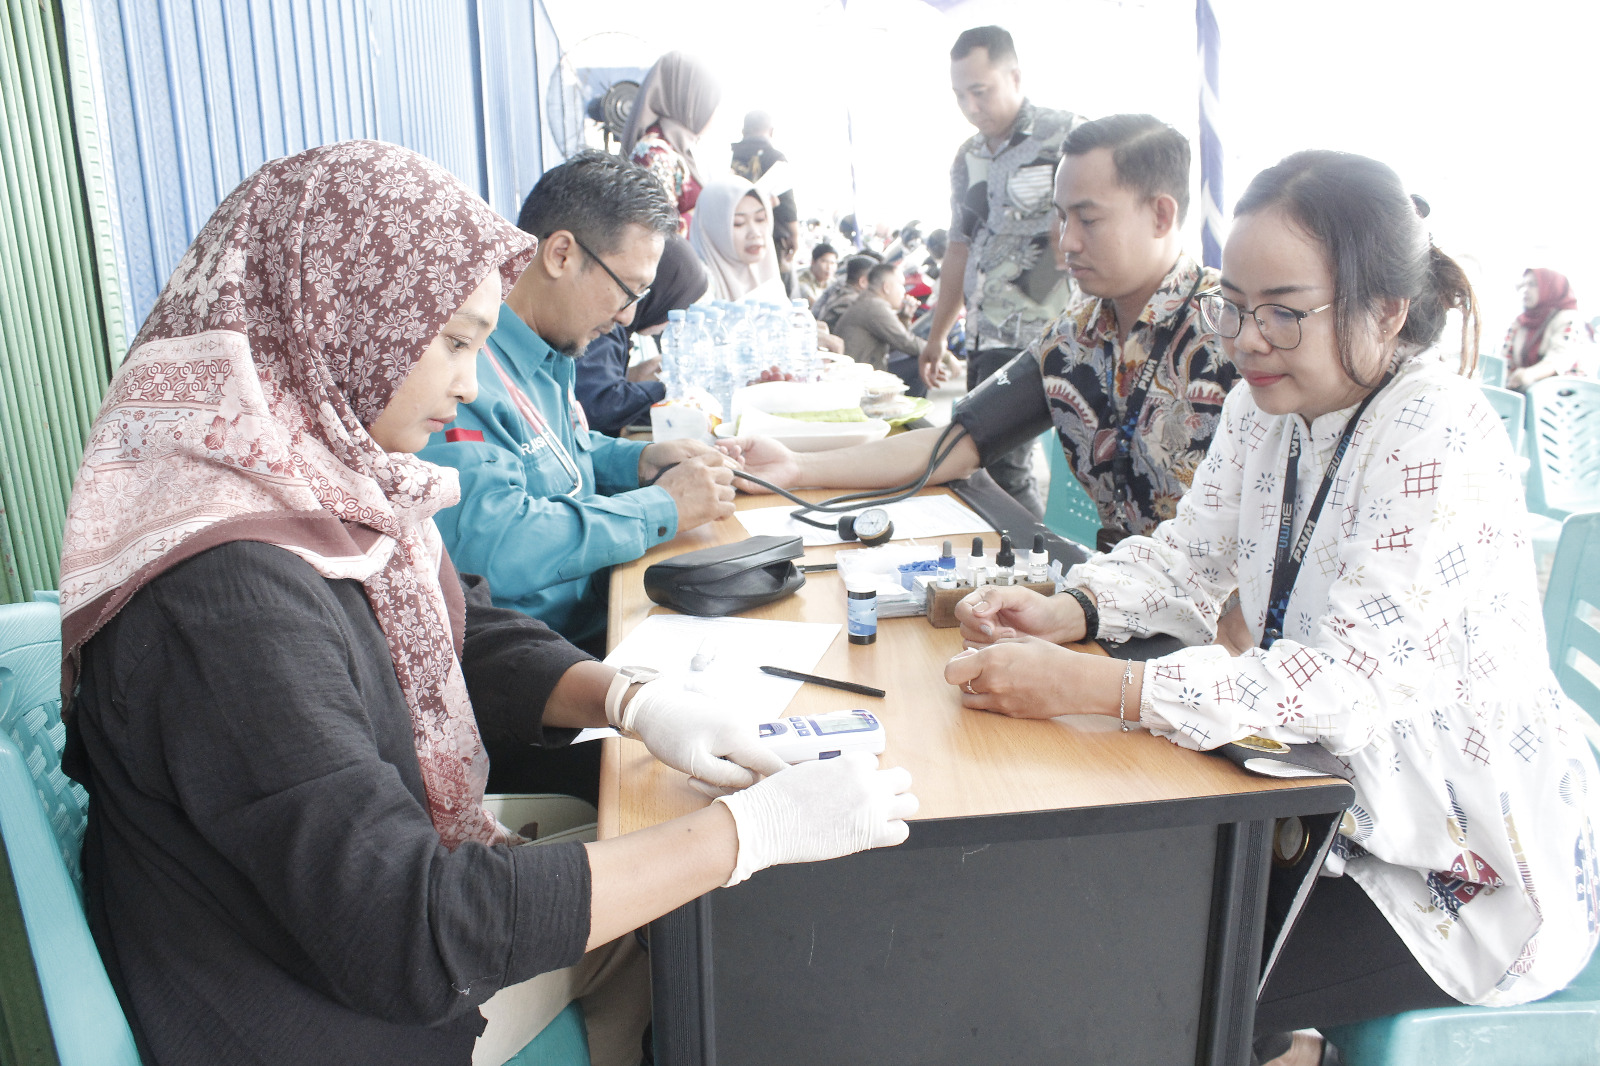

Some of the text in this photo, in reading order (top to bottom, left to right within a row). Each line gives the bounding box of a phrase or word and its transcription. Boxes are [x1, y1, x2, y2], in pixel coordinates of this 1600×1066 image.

[1138, 358, 1158, 391] PNM
[1278, 503, 1293, 548] BUMN
[1293, 519, 1317, 563] PNM
